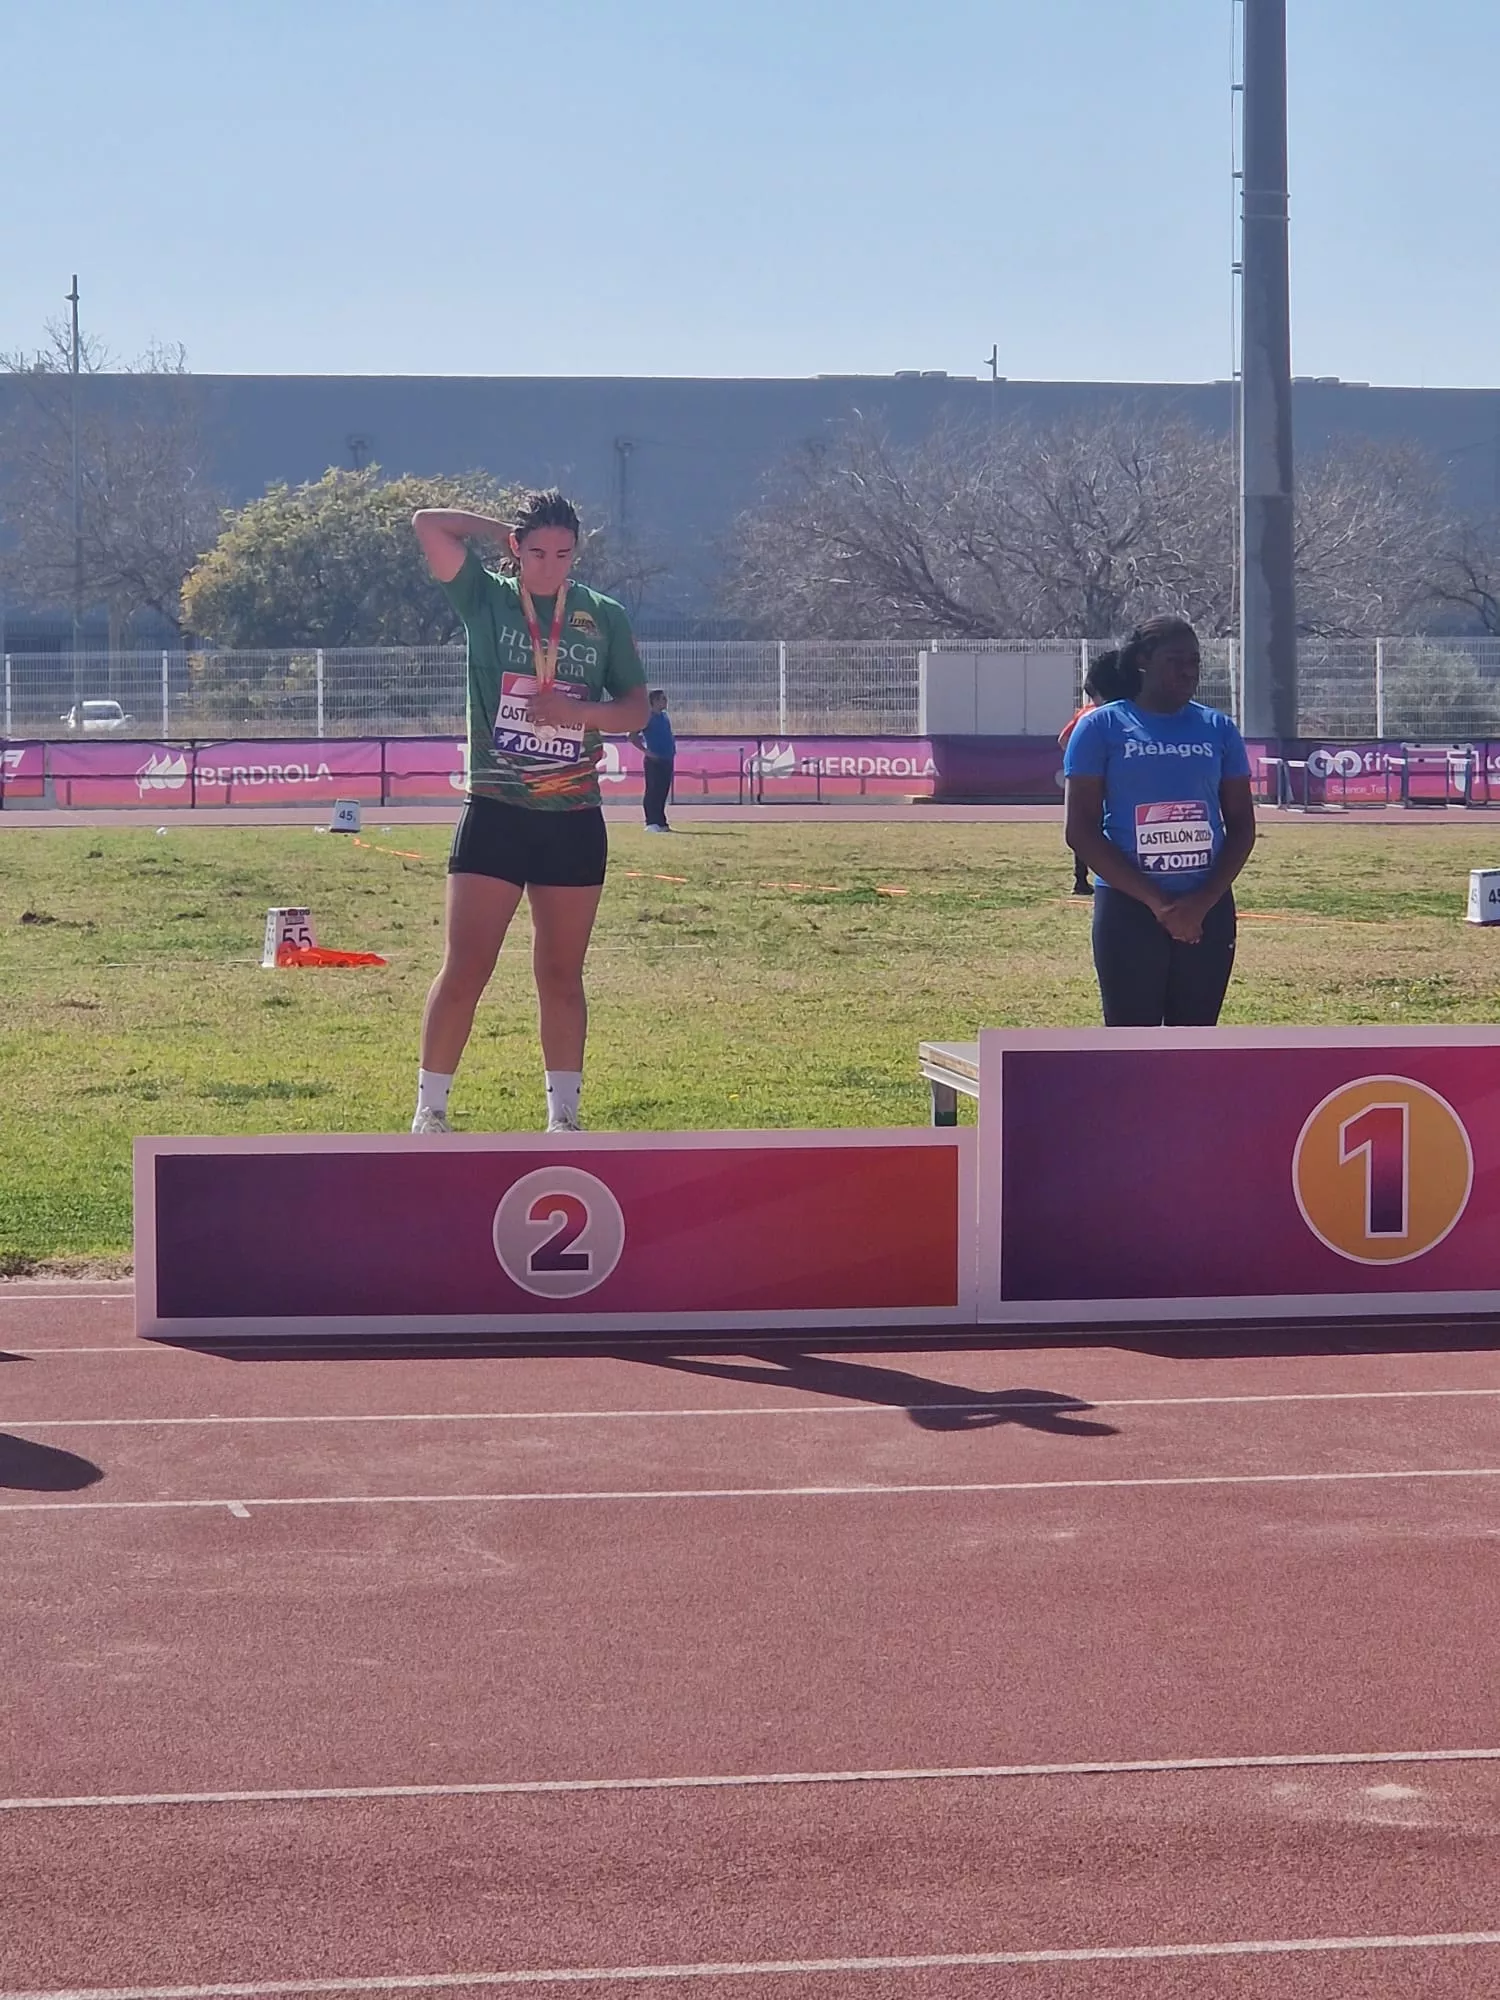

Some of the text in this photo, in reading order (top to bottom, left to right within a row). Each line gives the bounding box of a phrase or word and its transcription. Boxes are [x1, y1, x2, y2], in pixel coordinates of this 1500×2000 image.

[194, 763, 334, 787] IBERDROLA
[801, 756, 940, 777] IBERDROLA
[1141, 828, 1193, 845] CASTELLÓN
[1339, 1102, 1409, 1239] 1
[525, 1190, 593, 1276] 2
